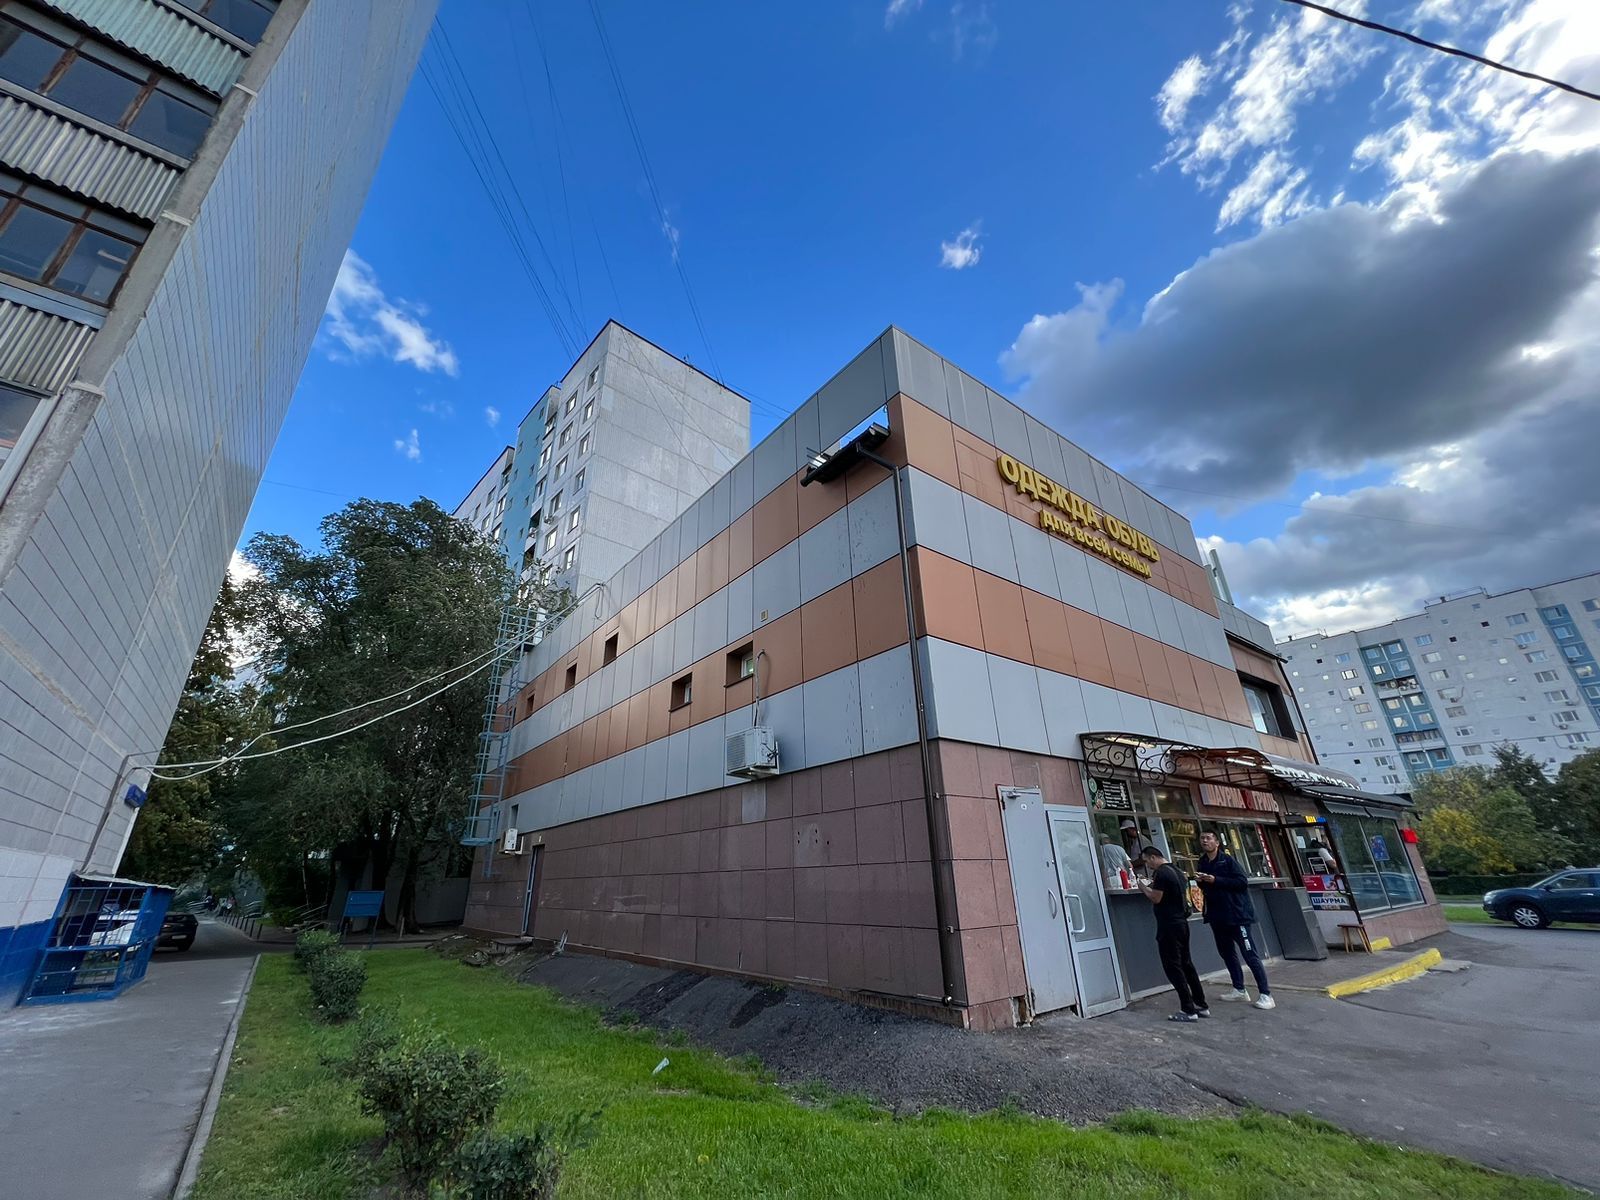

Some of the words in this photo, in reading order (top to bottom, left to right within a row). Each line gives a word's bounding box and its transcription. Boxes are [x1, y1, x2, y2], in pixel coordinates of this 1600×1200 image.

[997, 454, 1101, 531] ОДЕЖДА
[1103, 514, 1160, 563] ОБУВЬ
[1074, 527, 1111, 560] всей
[1111, 546, 1152, 578] семьи
[1312, 896, 1346, 905] ШАУРМА
